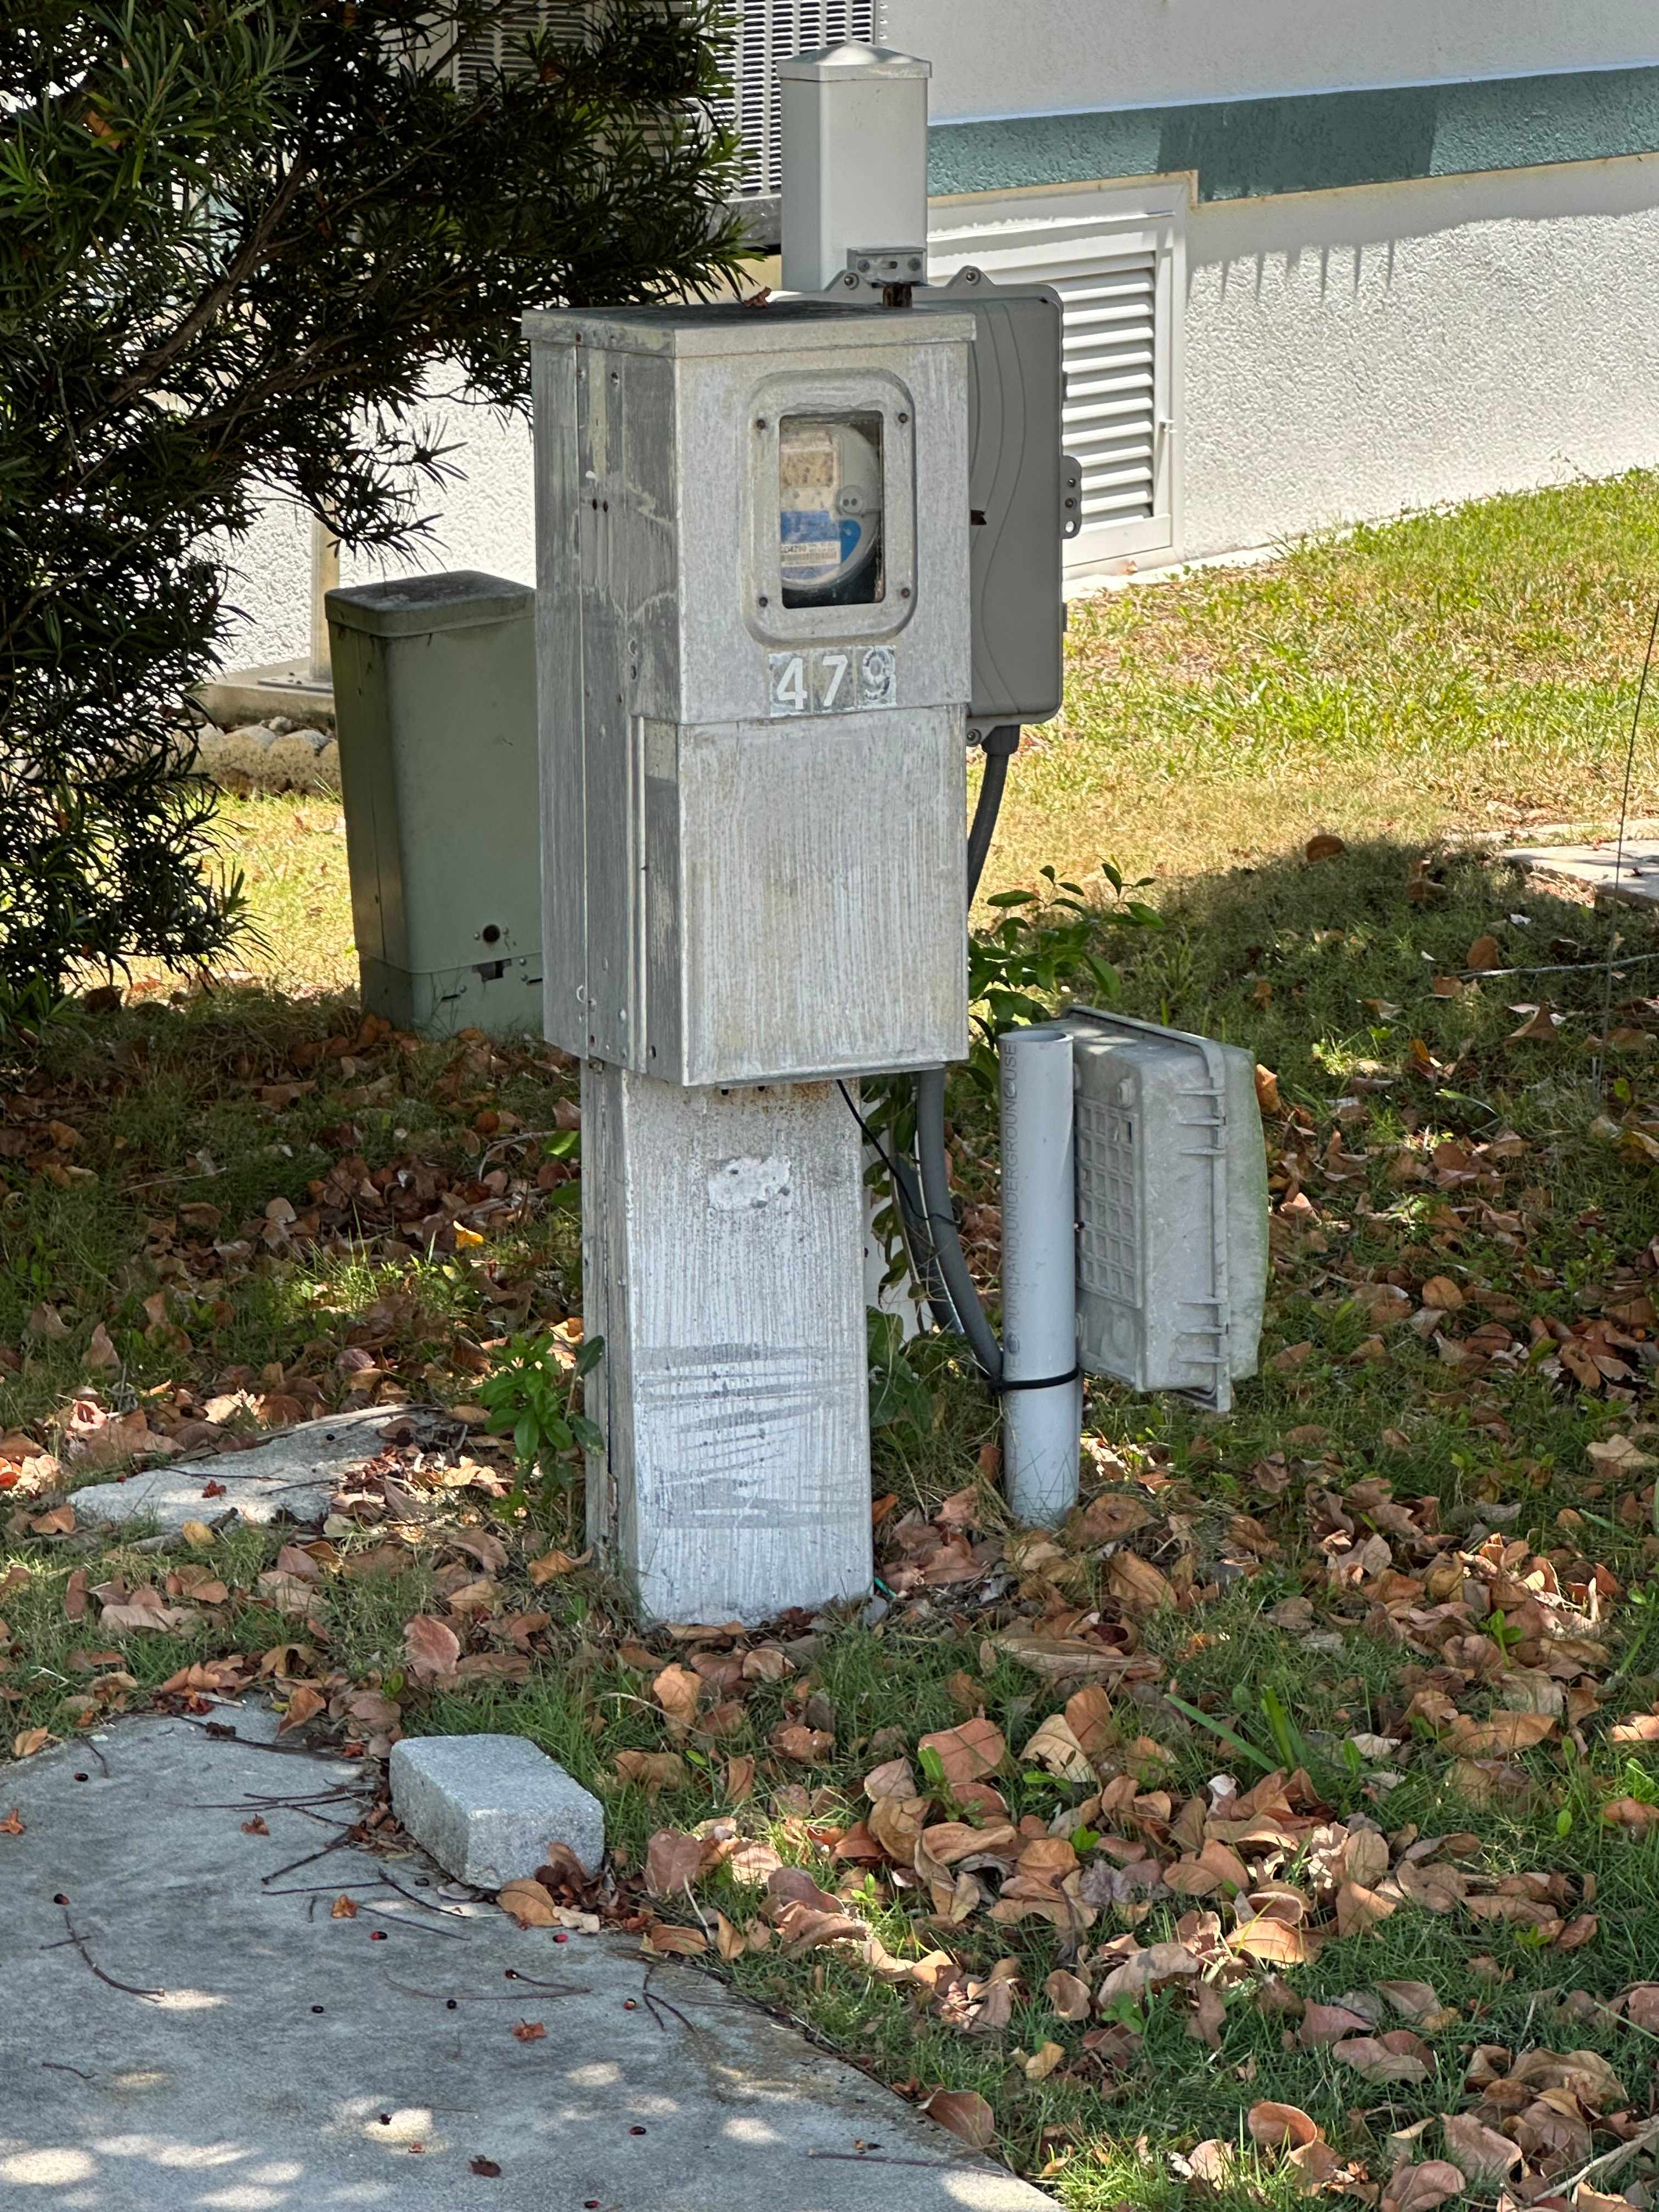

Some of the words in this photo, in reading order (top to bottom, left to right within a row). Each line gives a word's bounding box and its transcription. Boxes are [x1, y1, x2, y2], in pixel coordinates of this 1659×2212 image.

[777, 647, 895, 709] 479
[1004, 1043, 1017, 1080] USE
[1006, 1237, 1019, 1274] AND
[1006, 1276, 1019, 1352] OUND
[1007, 1358, 1020, 1418] ABVE
